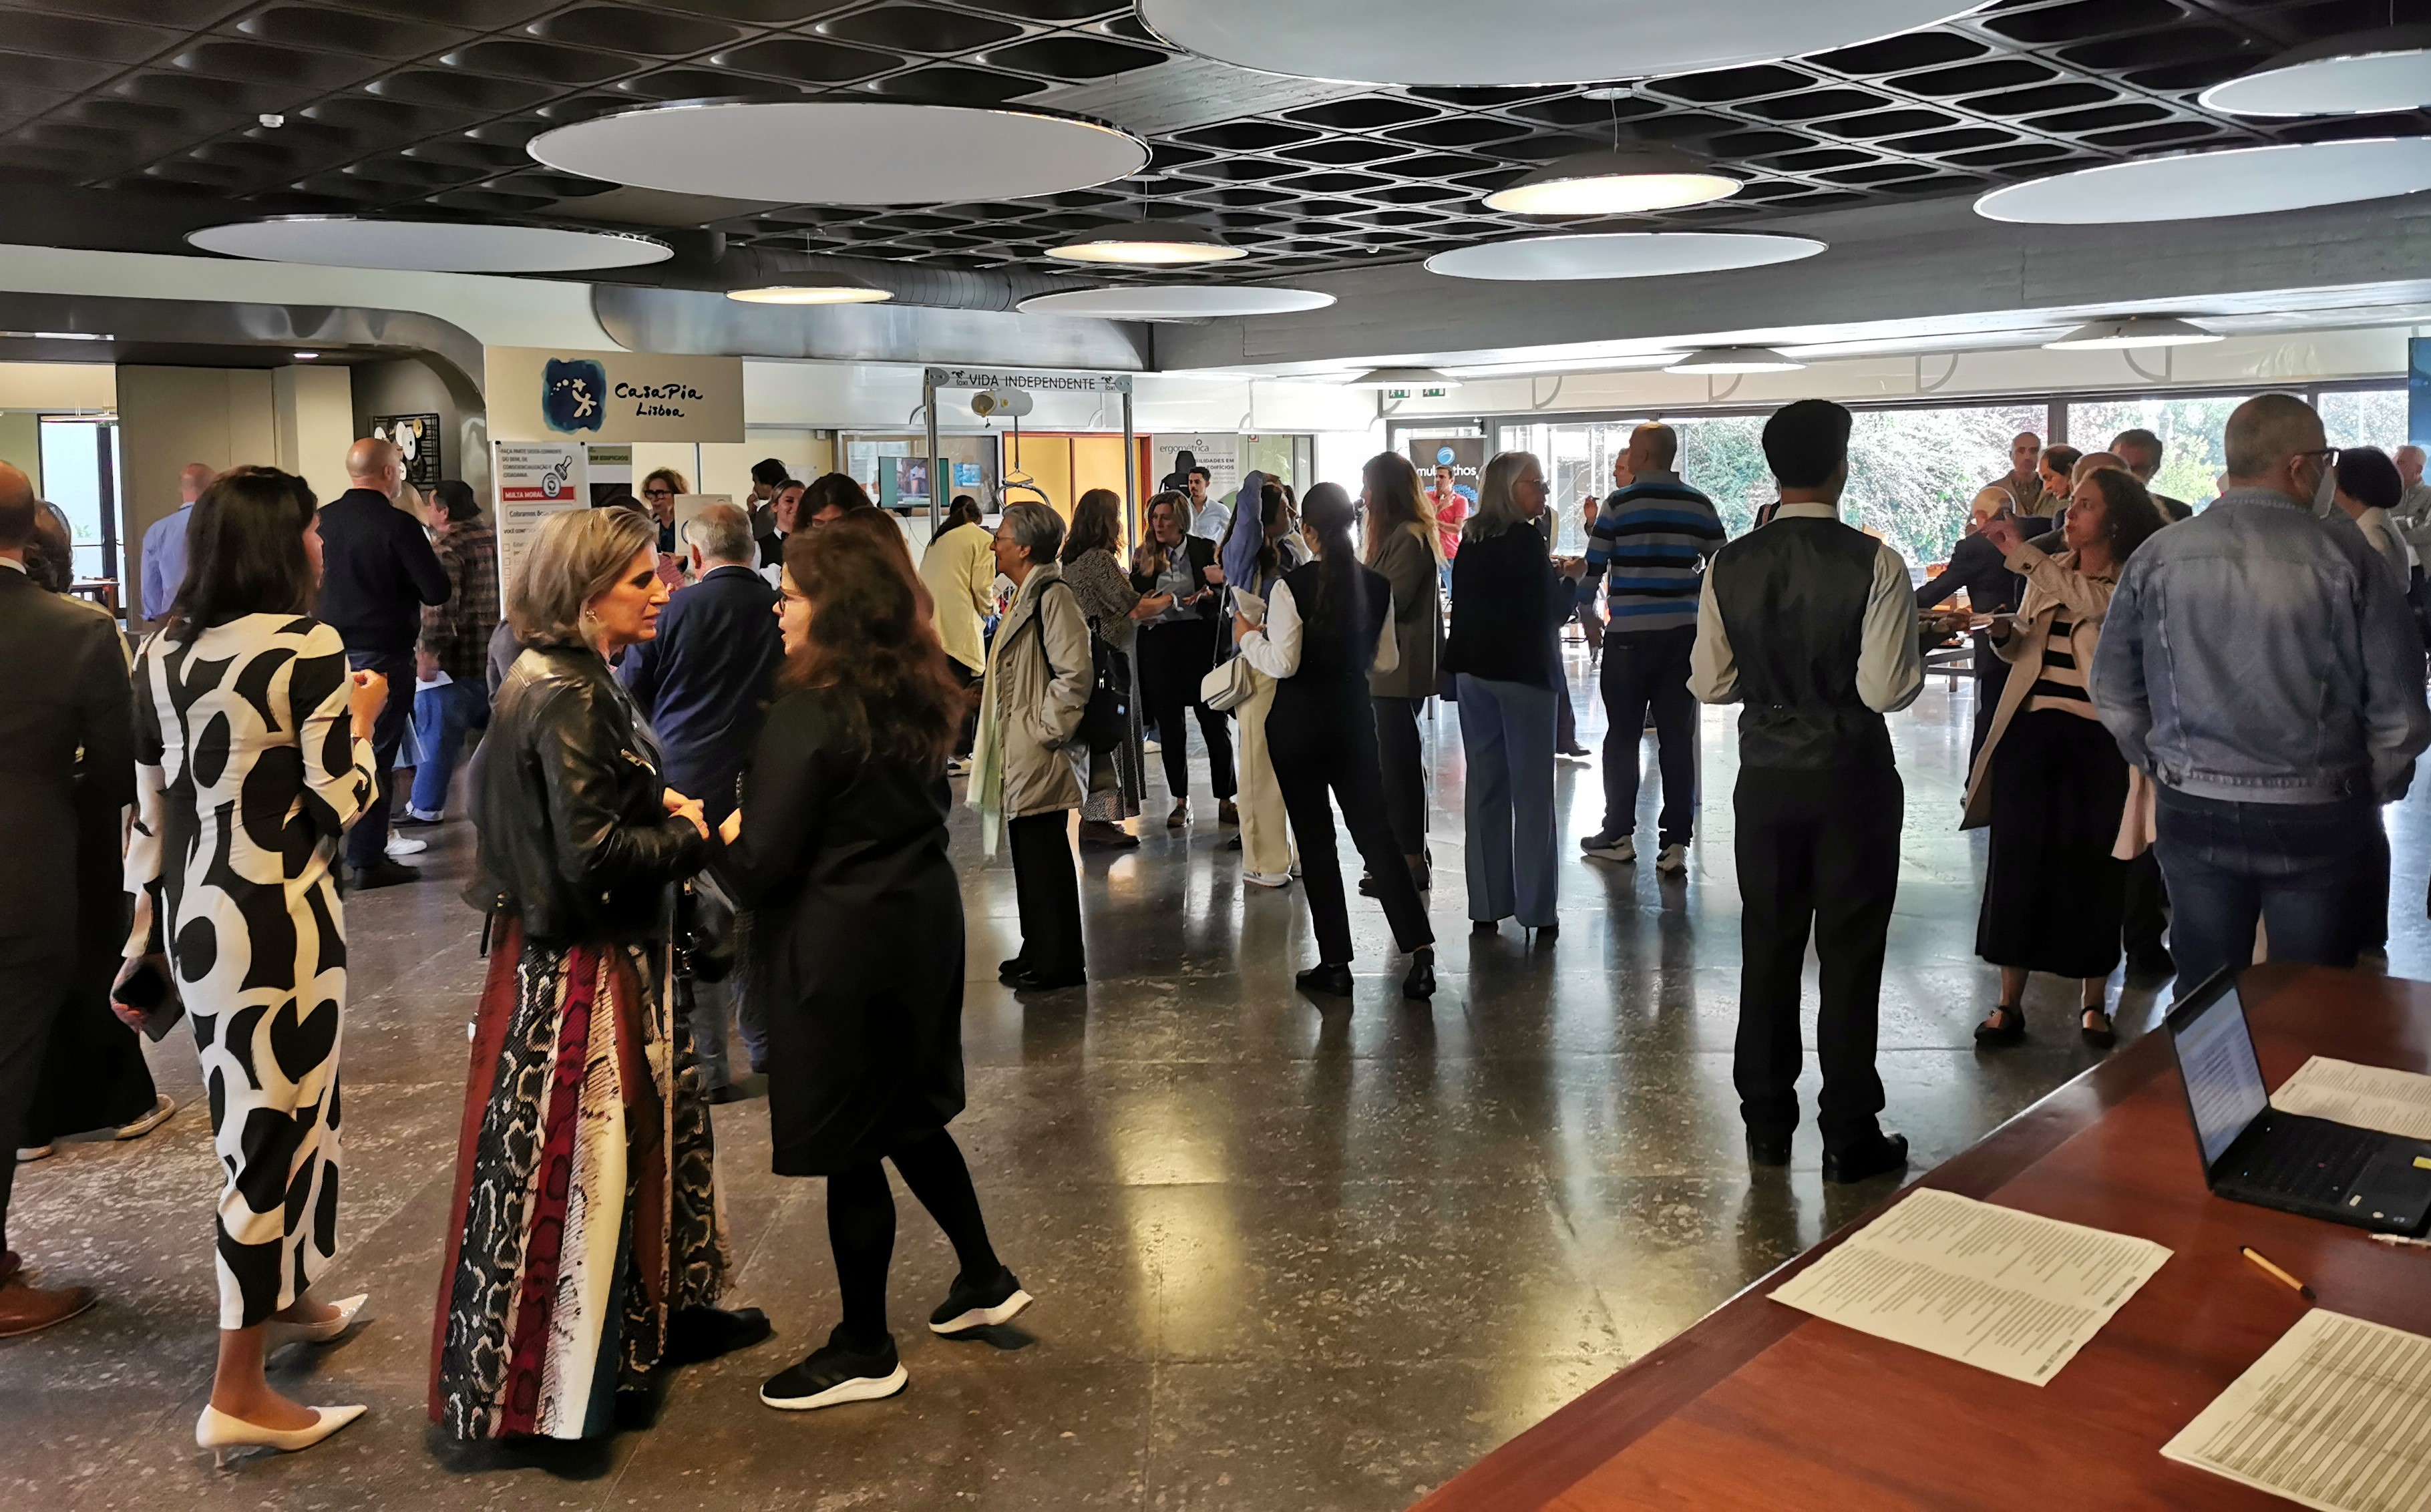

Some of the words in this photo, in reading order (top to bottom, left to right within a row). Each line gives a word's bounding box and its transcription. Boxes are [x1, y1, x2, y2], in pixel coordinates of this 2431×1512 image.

[969, 374, 999, 387] VIDA
[1005, 375, 1095, 390] INDEPENDENTE
[636, 402, 685, 417] Lisboa
[1159, 439, 1209, 454] ergométrica
